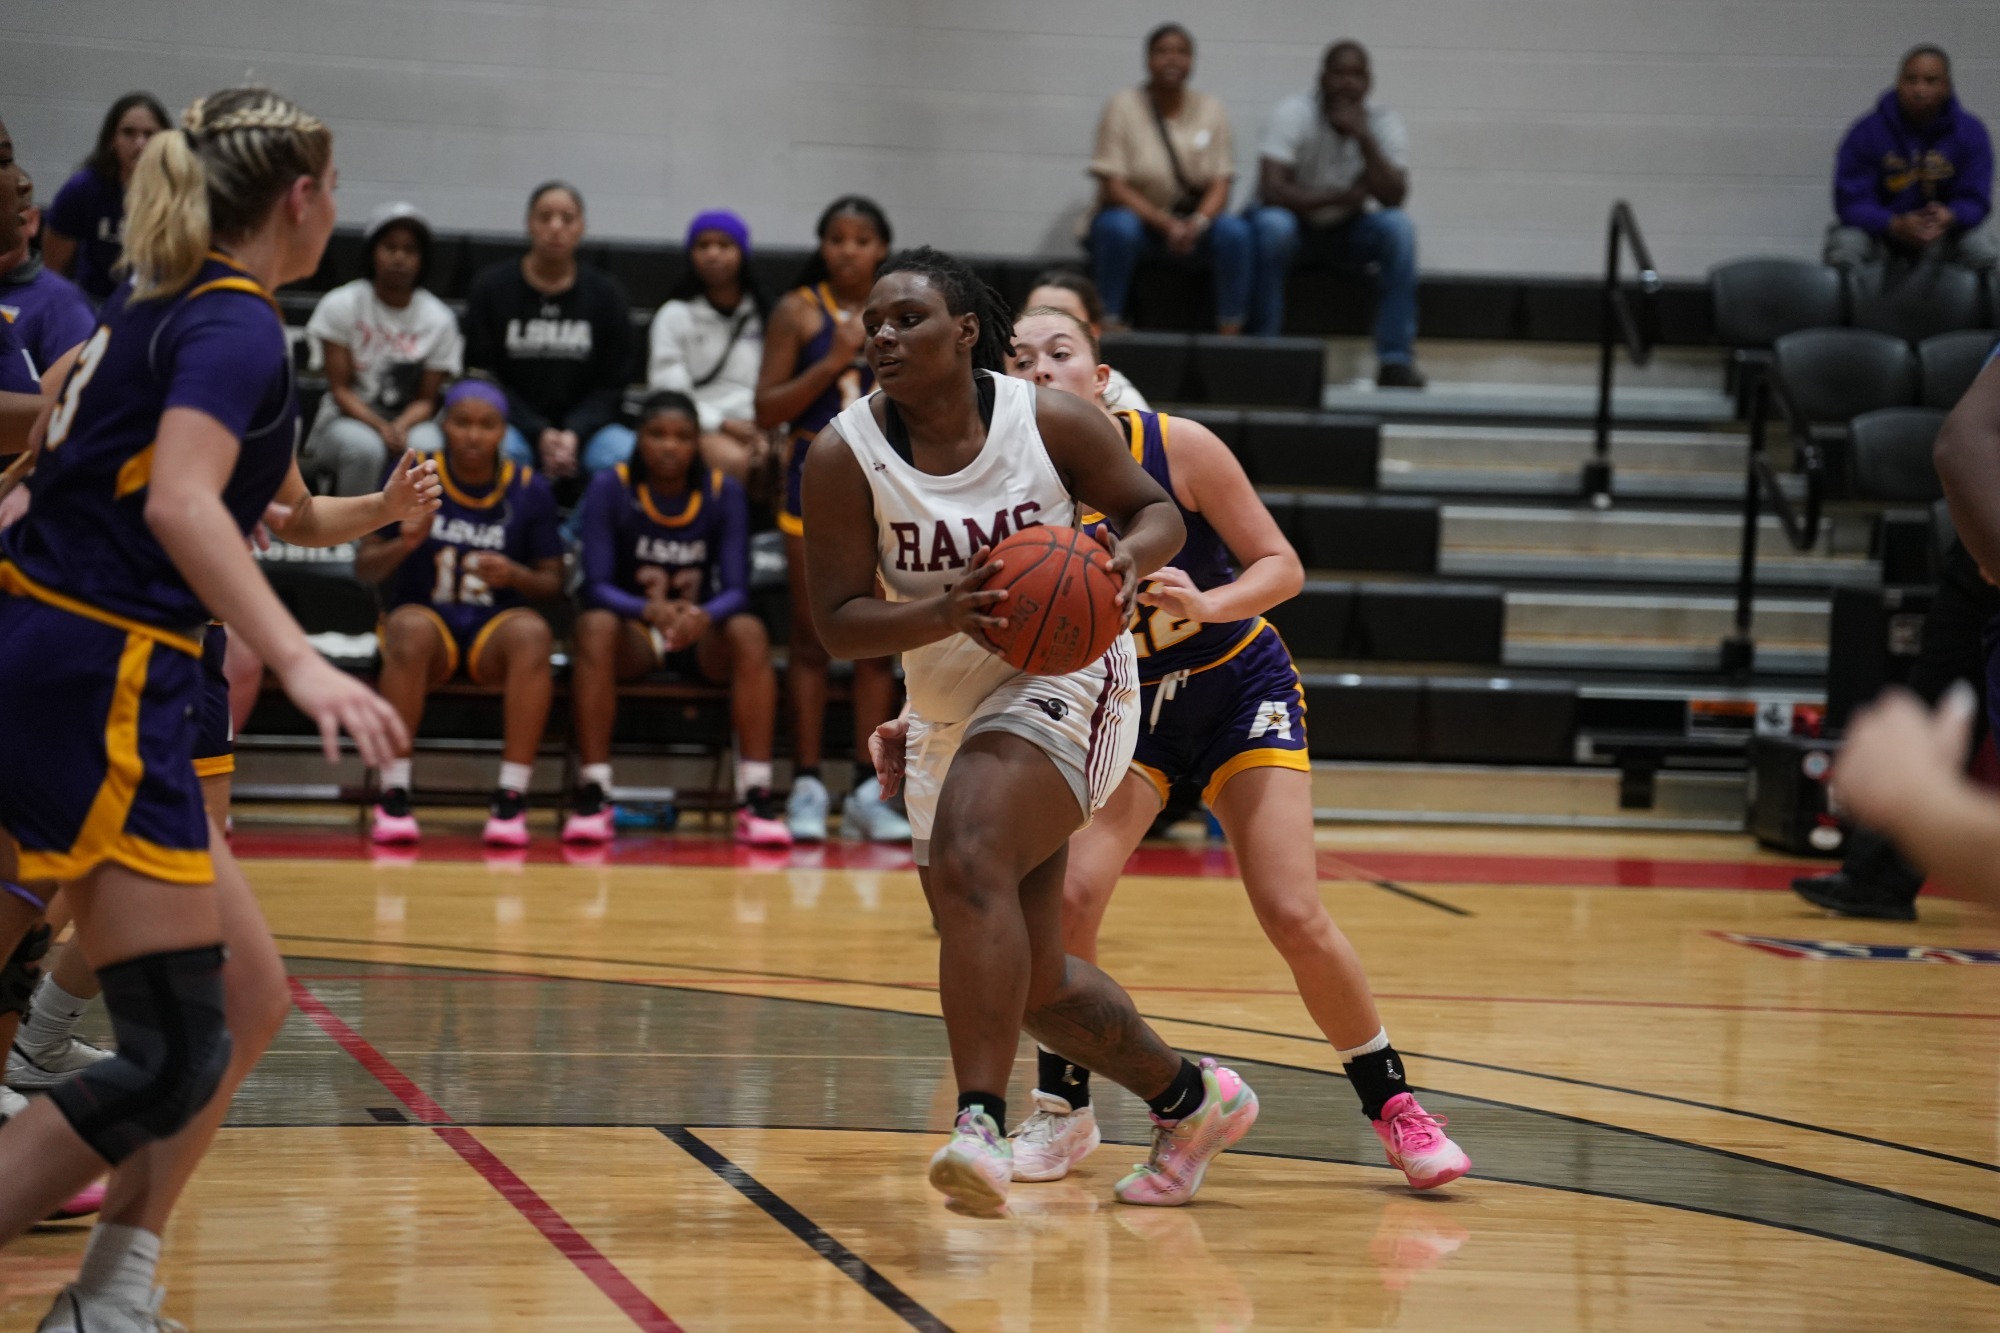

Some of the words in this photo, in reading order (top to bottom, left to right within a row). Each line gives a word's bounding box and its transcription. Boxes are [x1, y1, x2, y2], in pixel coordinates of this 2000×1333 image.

[505, 318, 592, 351] LSUA
[430, 514, 505, 550] LSUA
[890, 501, 1044, 572] RAMS
[635, 535, 707, 564] LSUA
